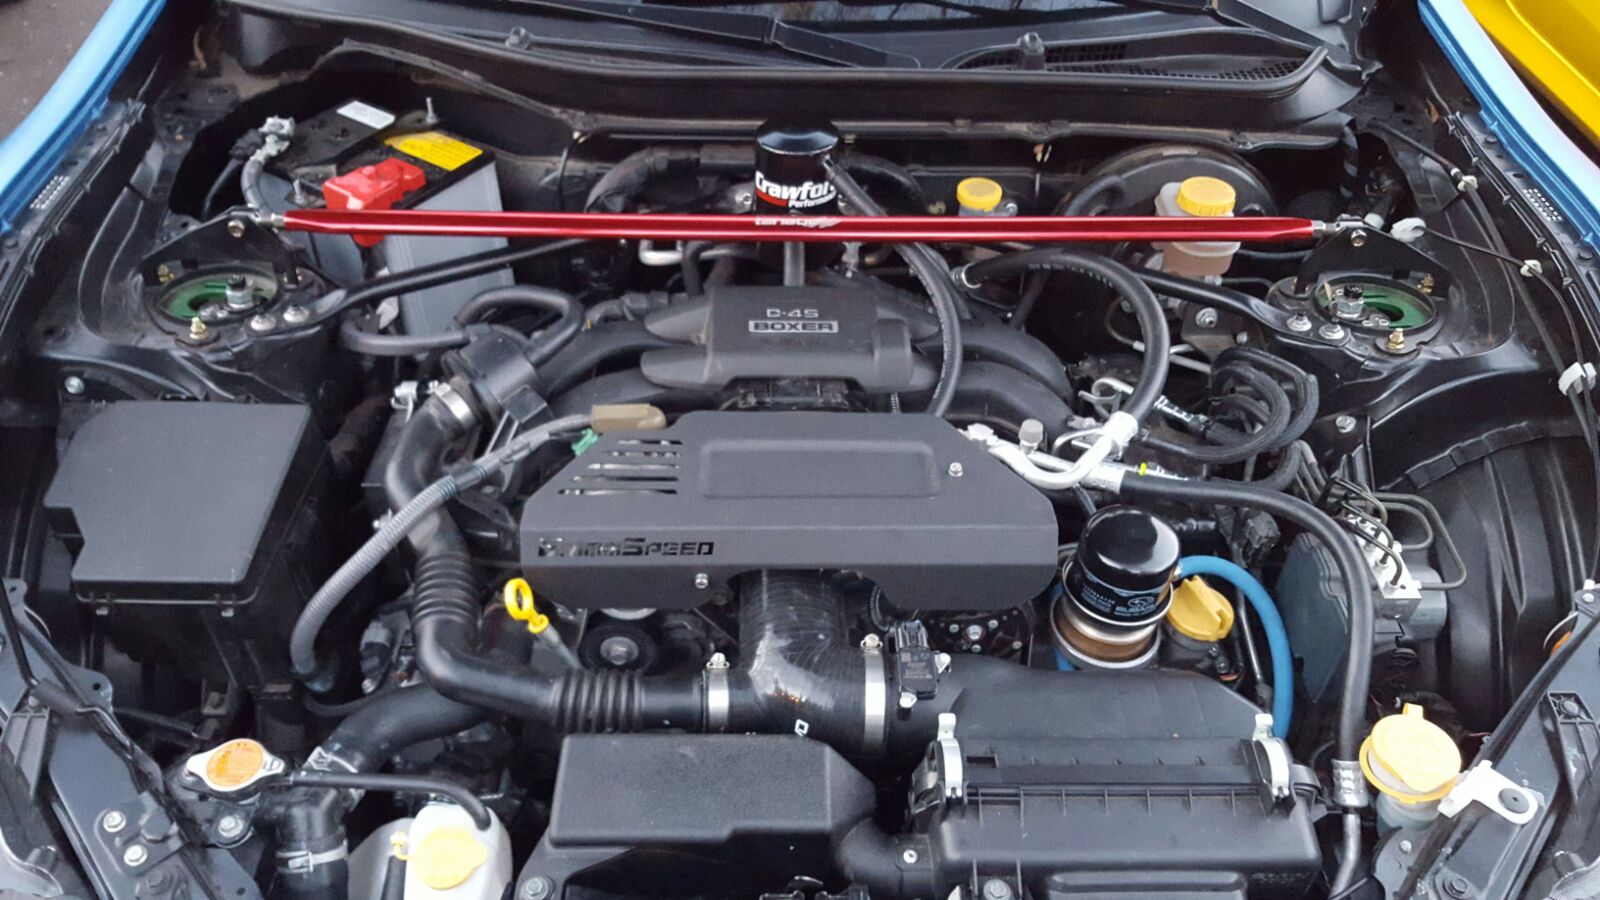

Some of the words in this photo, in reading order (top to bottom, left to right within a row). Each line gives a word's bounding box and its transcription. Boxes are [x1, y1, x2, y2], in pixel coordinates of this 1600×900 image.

[788, 189, 837, 208] Perform
[766, 308, 818, 318] D-4S
[753, 322, 834, 332] BOXER
